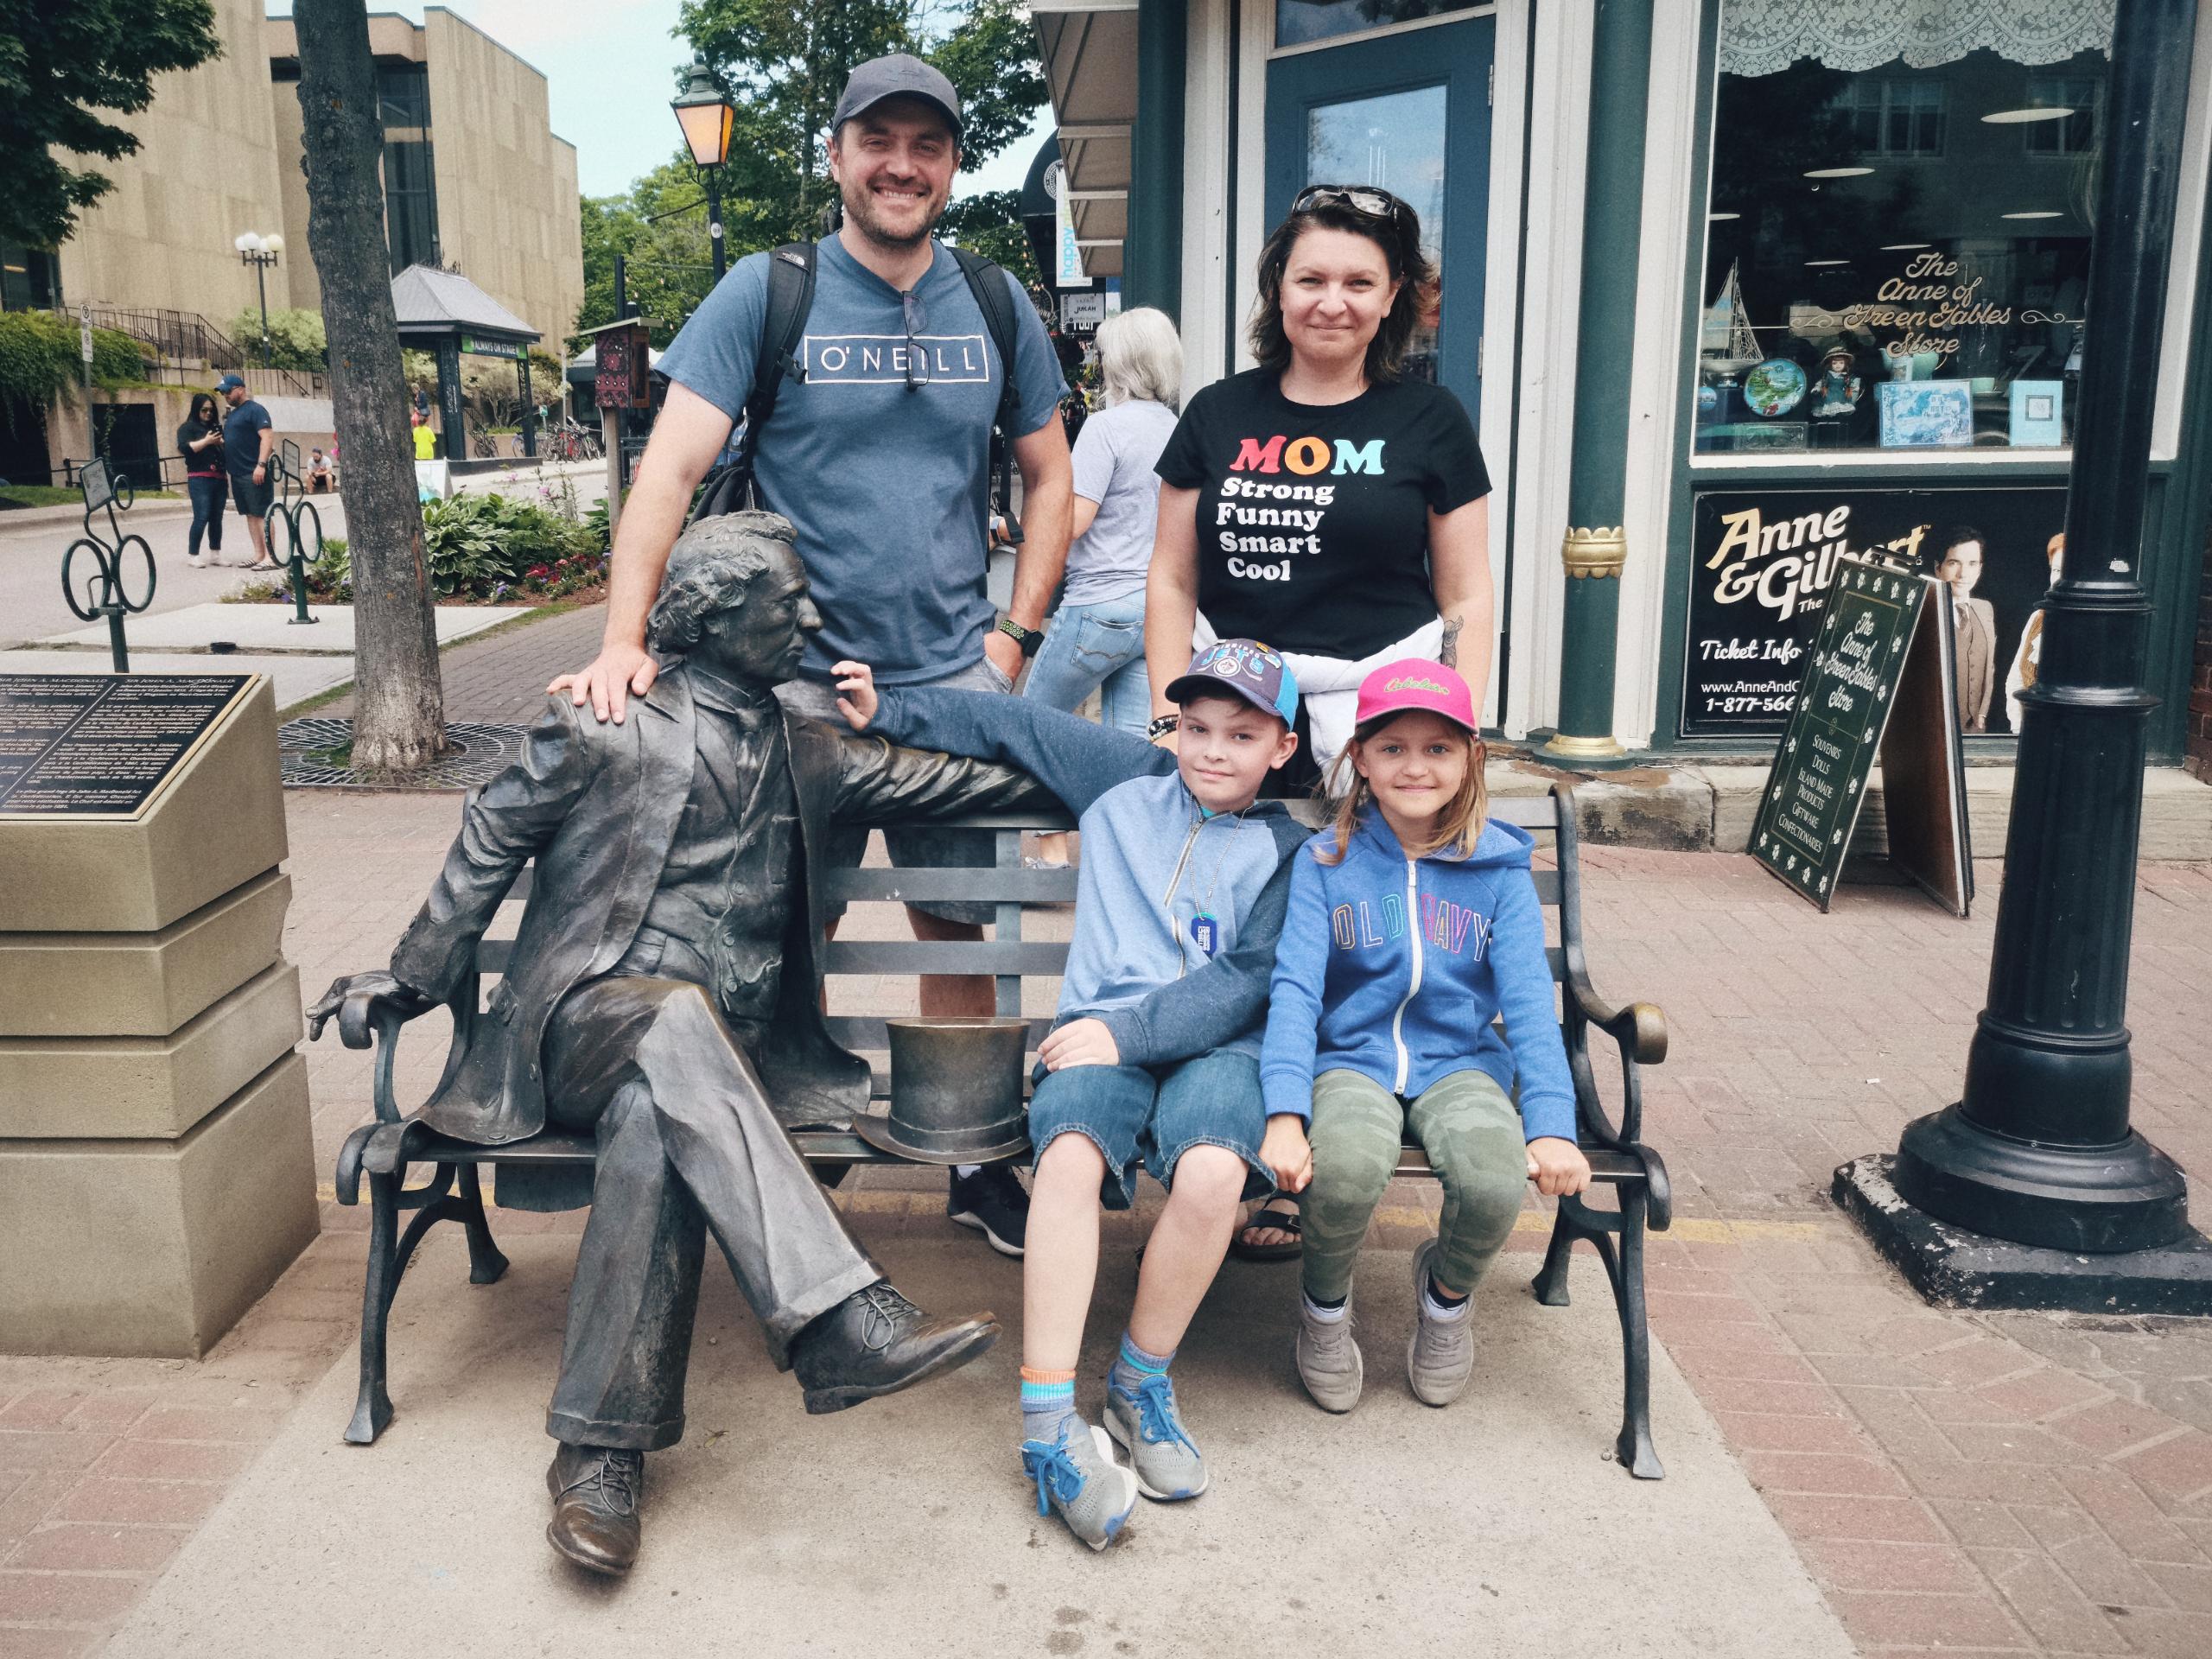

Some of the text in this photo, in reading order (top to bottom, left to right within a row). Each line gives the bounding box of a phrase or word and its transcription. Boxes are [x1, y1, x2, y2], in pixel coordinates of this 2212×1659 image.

[1905, 251, 1958, 278] The
[1877, 276, 1983, 308] Anne of
[1843, 301, 2012, 330] Green Gables
[821, 346, 976, 371] O'NEILL
[1885, 332, 1961, 359] Store
[1229, 435, 1386, 475] MOM
[1220, 477, 1336, 505] Strong
[1216, 502, 1325, 531] Funny
[1219, 531, 1322, 555] Smart
[1705, 505, 1850, 570] Anne
[1227, 557, 1291, 582] Cool
[1798, 598, 1825, 613] The
[1855, 611, 1874, 636] The
[1700, 639, 1759, 660] Ticket
[1759, 639, 1802, 665] Info
[1840, 631, 1878, 669] Anne of
[1824, 651, 1878, 691] Green Gables
[1828, 684, 1853, 712] Store
[1811, 755, 1831, 775] DOLLS
[1332, 893, 1404, 950] OLD
